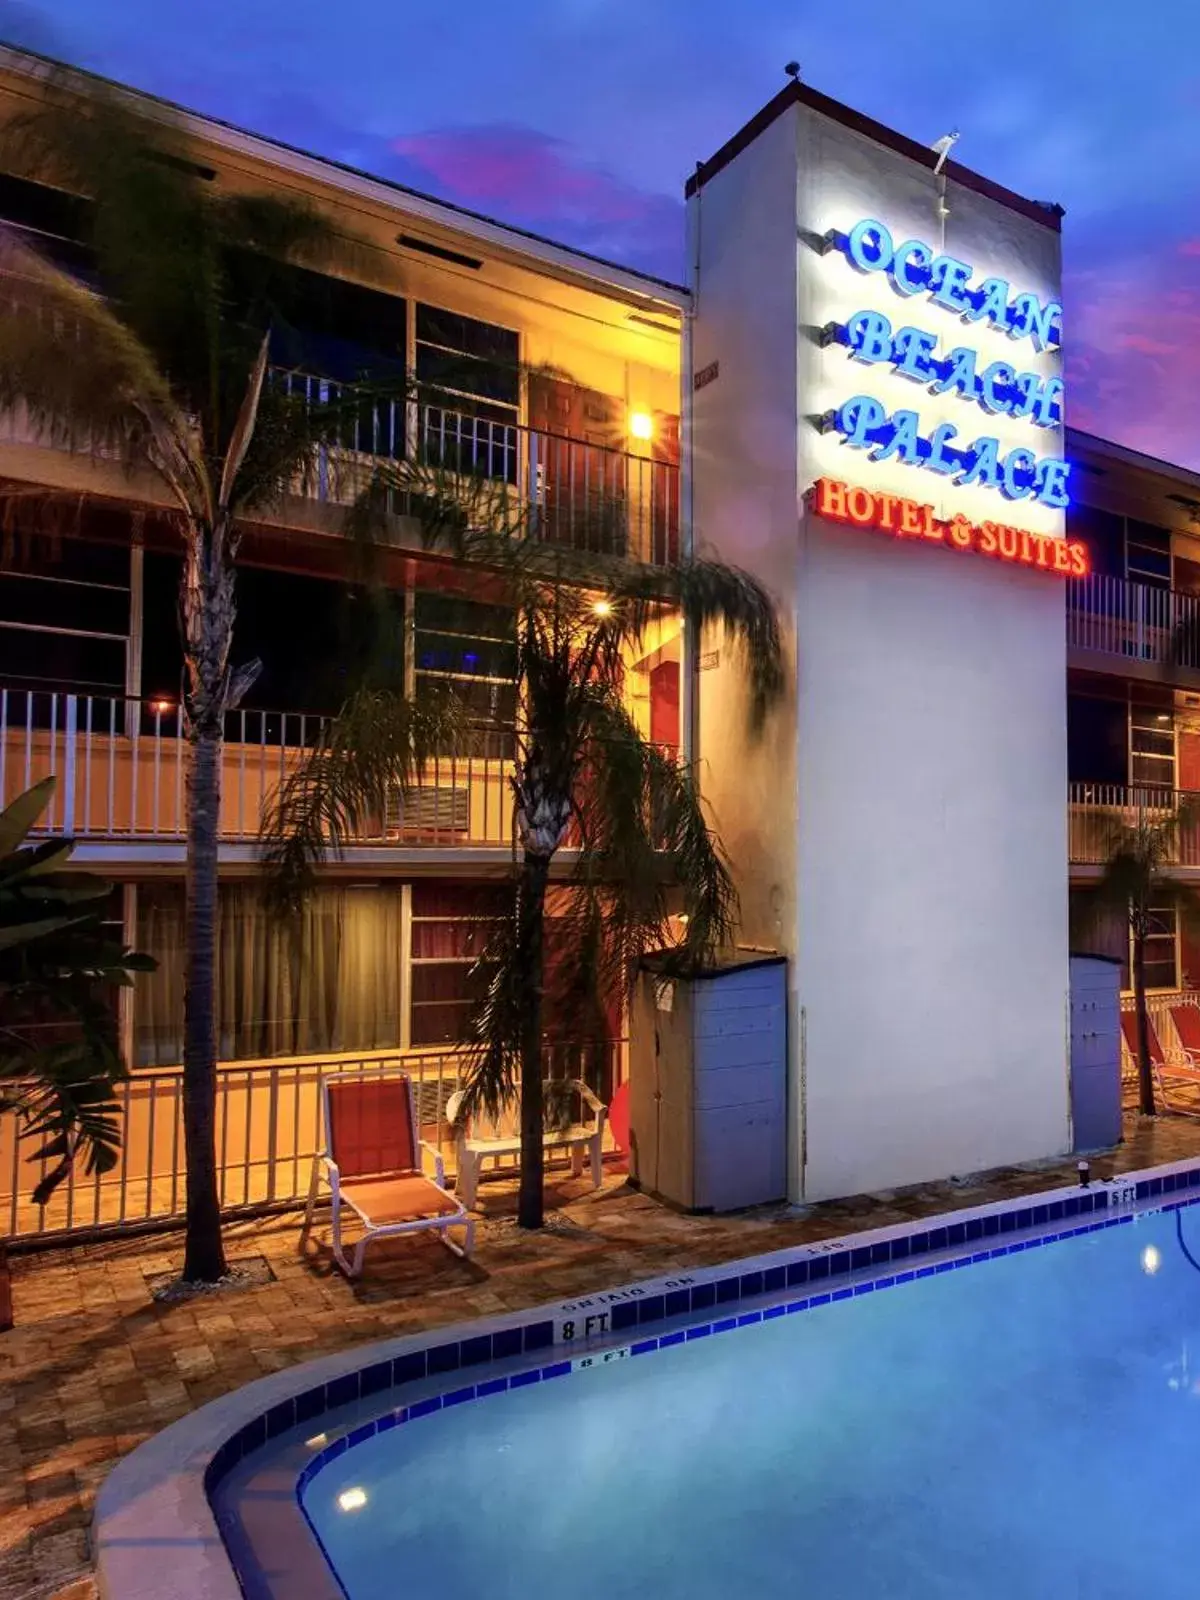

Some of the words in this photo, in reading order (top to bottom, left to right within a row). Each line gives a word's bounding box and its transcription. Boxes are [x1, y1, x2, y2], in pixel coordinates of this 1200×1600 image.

[847, 218, 1062, 353] OCEAN
[844, 308, 1064, 427] BEACH
[839, 394, 1071, 509] PALACE
[821, 480, 942, 540] HOTEL
[951, 512, 971, 546] &
[981, 520, 1089, 575] SUITES
[1122, 1187, 1136, 1202] FT
[561, 1286, 645, 1313] DIVING
[664, 1276, 696, 1289] NO
[562, 1321, 575, 1341] 8
[584, 1312, 610, 1336] FT
